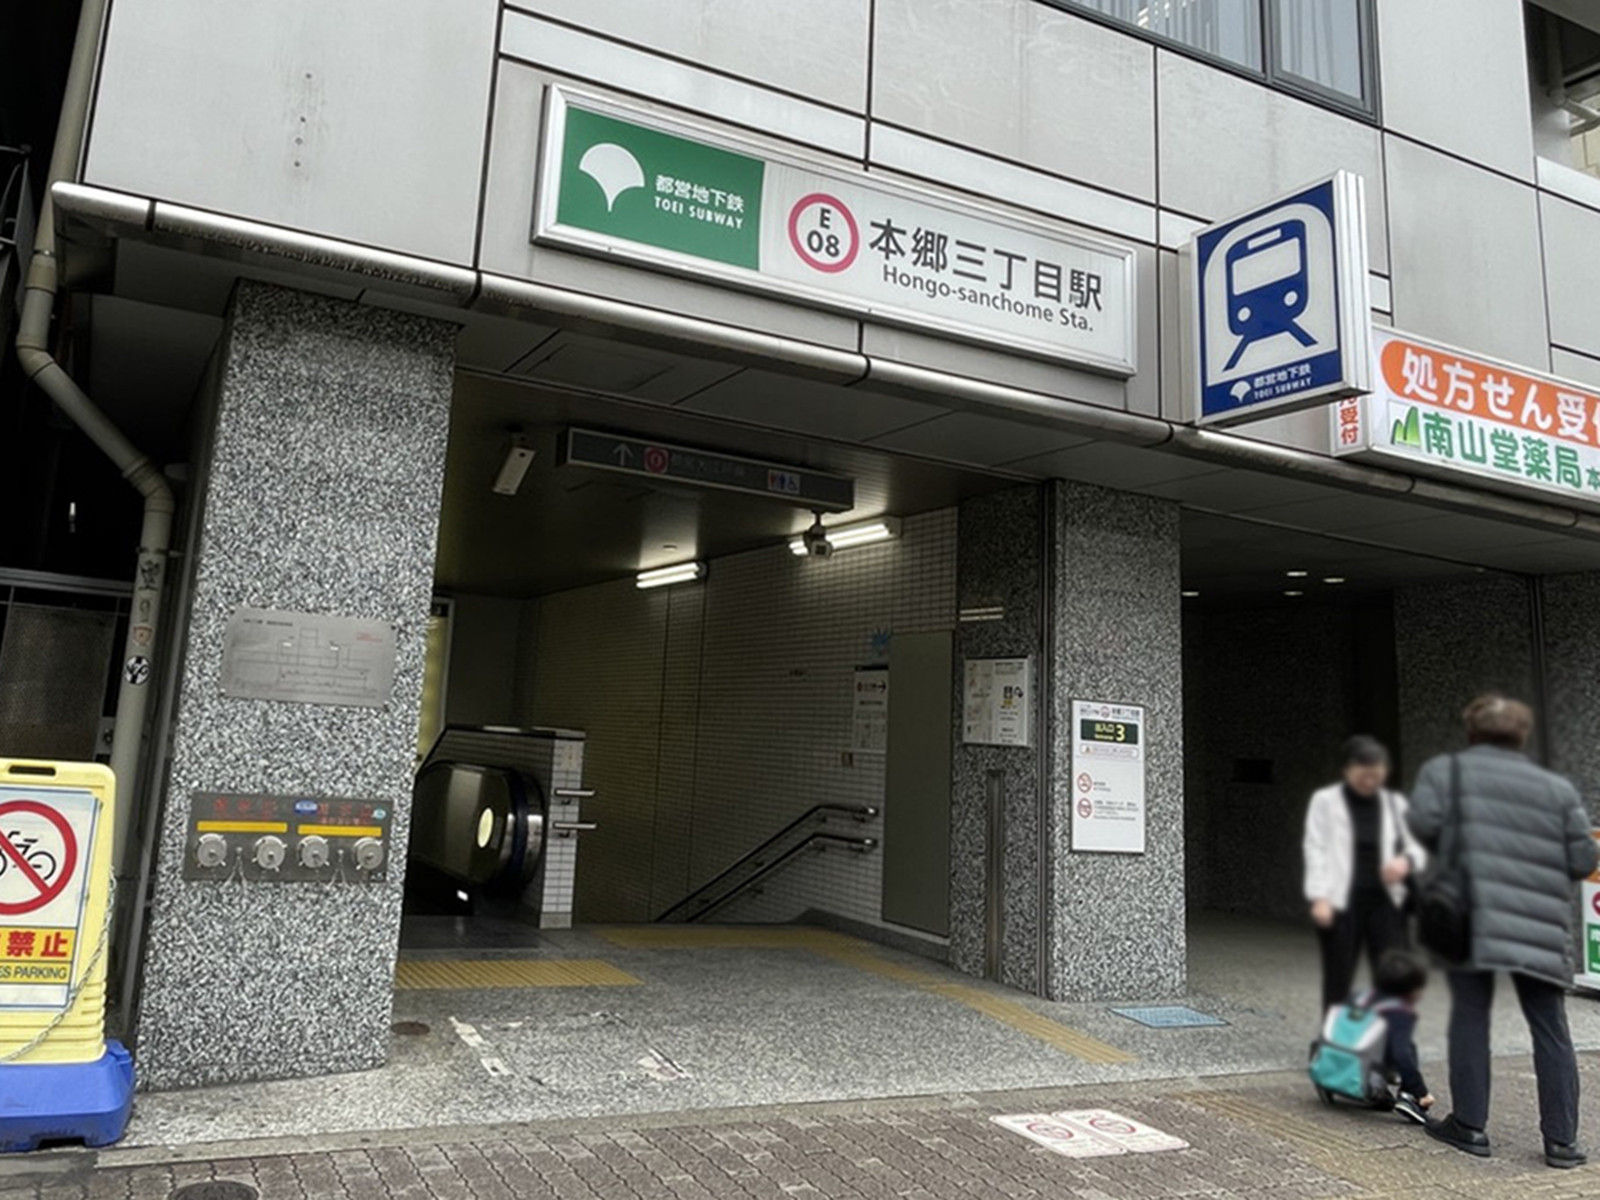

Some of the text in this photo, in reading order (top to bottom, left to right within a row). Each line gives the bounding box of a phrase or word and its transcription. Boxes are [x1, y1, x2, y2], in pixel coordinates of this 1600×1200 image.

[655, 174, 745, 213] 都営地下鉄
[654, 197, 743, 230] TOEI SUBWAY
[819, 207, 831, 229] E
[807, 230, 840, 257] 08
[869, 218, 1103, 311] 本郷三丁目駅
[882, 264, 1094, 332] Hongo-sanchome Sta.
[1254, 363, 1312, 388] 都営地下鉄
[1276, 378, 1312, 394] SUBWAY
[1402, 350, 1600, 443] 処方せん受
[1116, 724, 1126, 741] 3
[14, 965, 67, 979] PARKING
